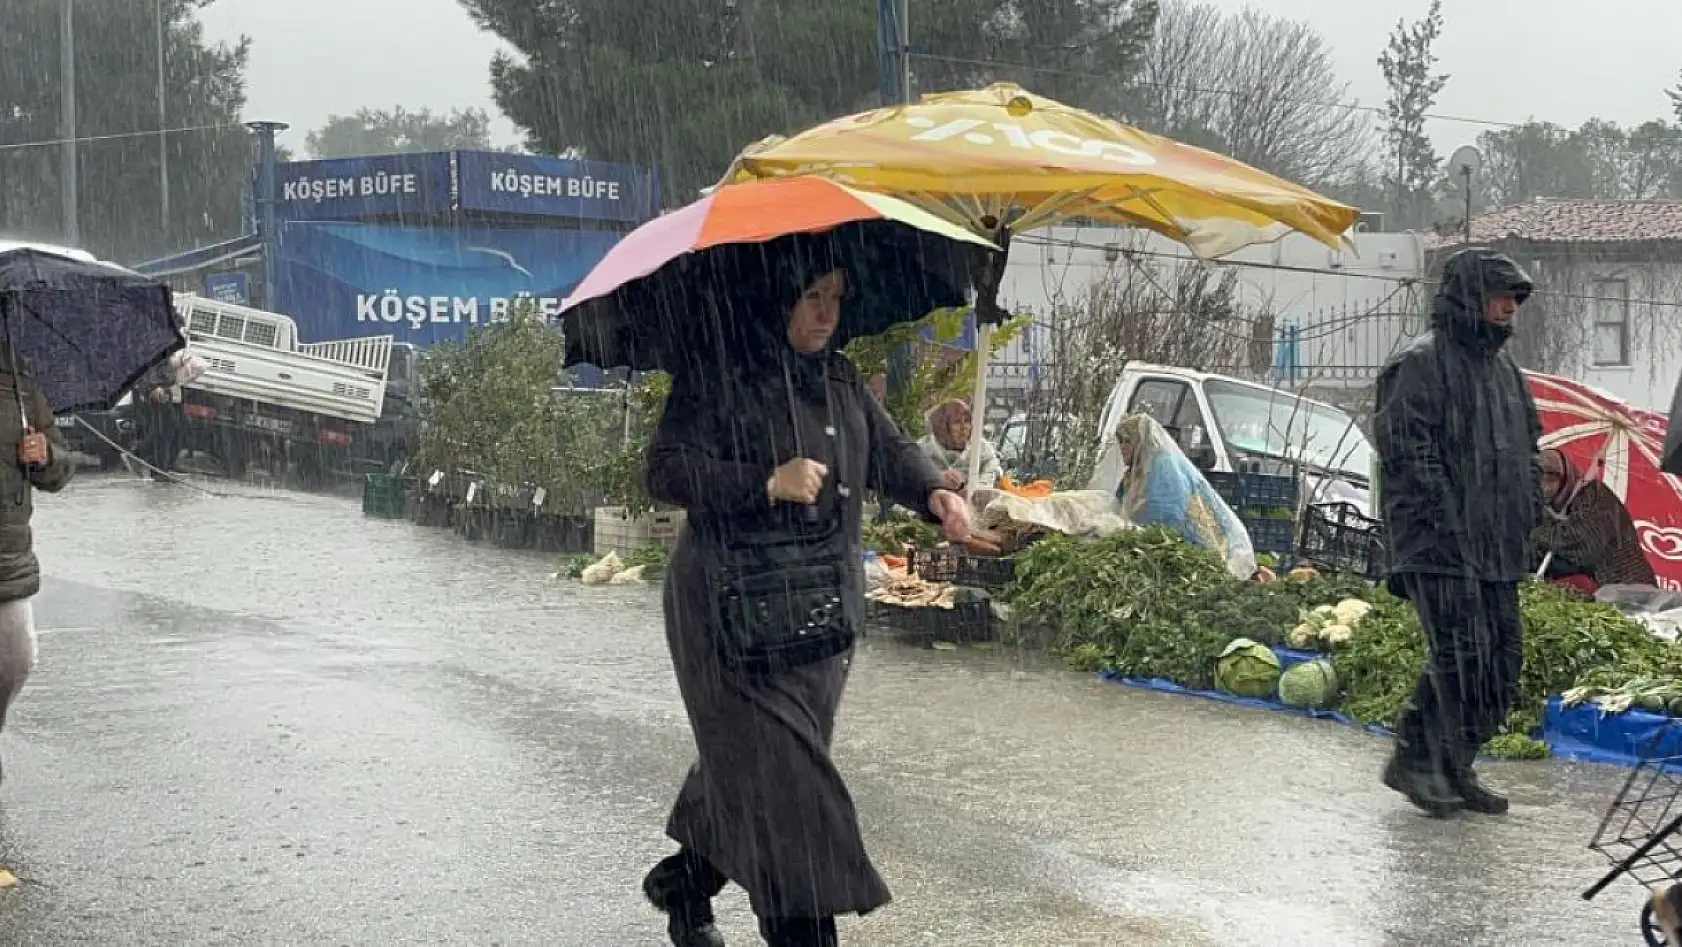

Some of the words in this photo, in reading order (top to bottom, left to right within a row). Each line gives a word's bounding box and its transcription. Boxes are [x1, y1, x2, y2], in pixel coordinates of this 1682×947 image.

[284, 176, 353, 203] KÖŞEM
[361, 170, 416, 197] BÜFE
[491, 168, 562, 198] KÖŞEM
[567, 176, 620, 200] BÜFE
[357, 289, 478, 330] KÖŞEM
[489, 290, 567, 324] BÜF
